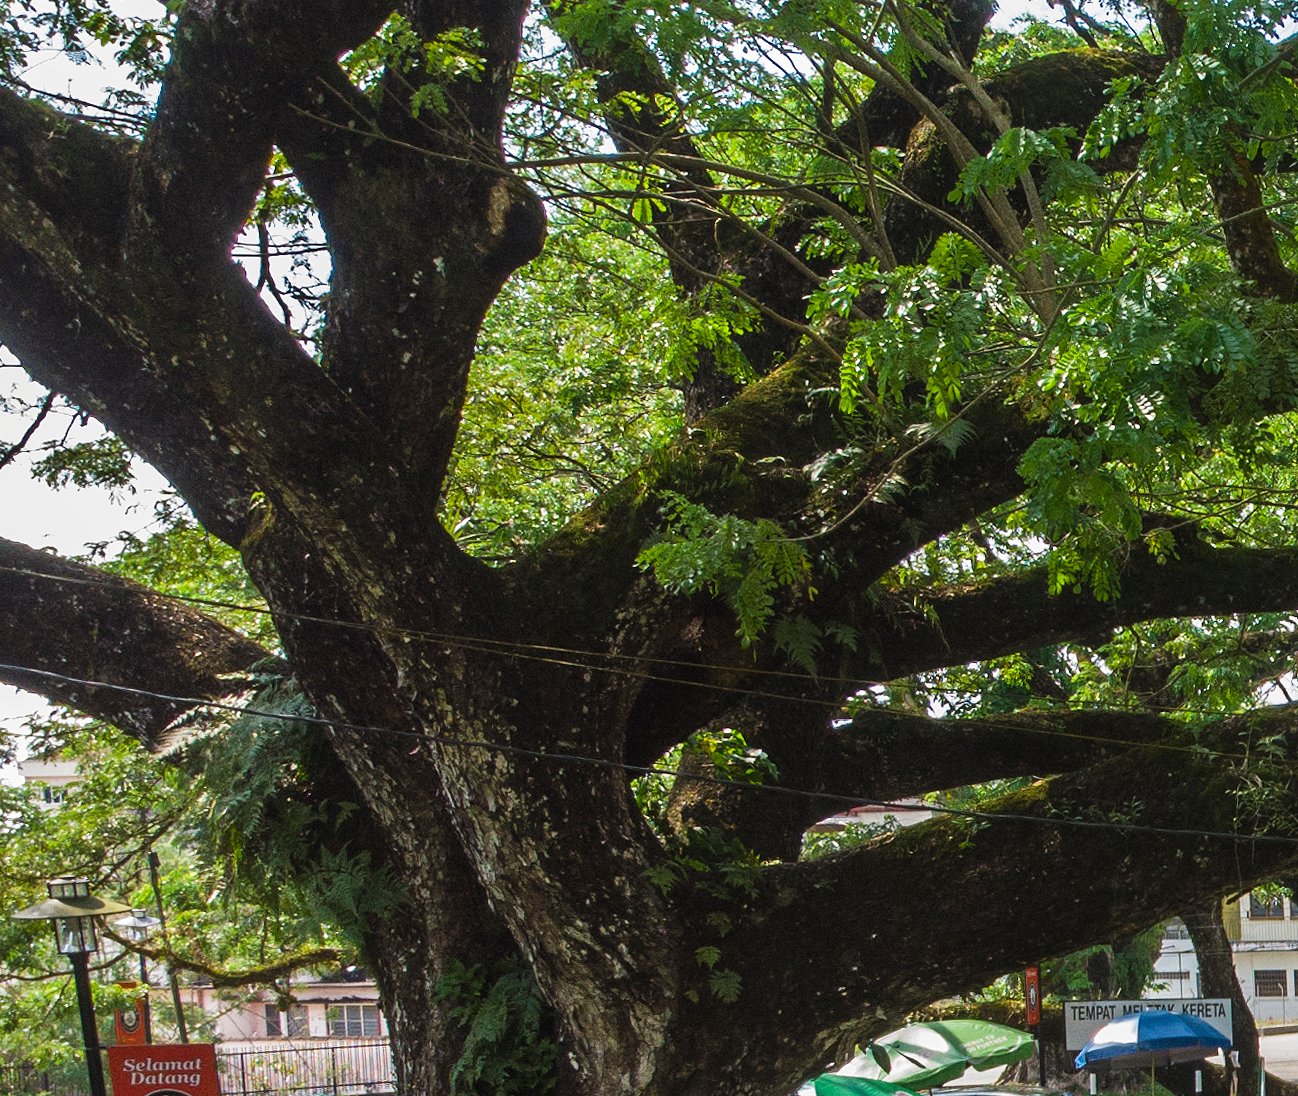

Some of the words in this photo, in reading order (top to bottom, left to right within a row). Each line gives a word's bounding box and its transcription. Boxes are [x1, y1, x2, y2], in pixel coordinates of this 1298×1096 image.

[1071, 1005, 1116, 1021] TEMPAT
[123, 1058, 202, 1072] Selamat
[131, 1072, 201, 1086] Datang
